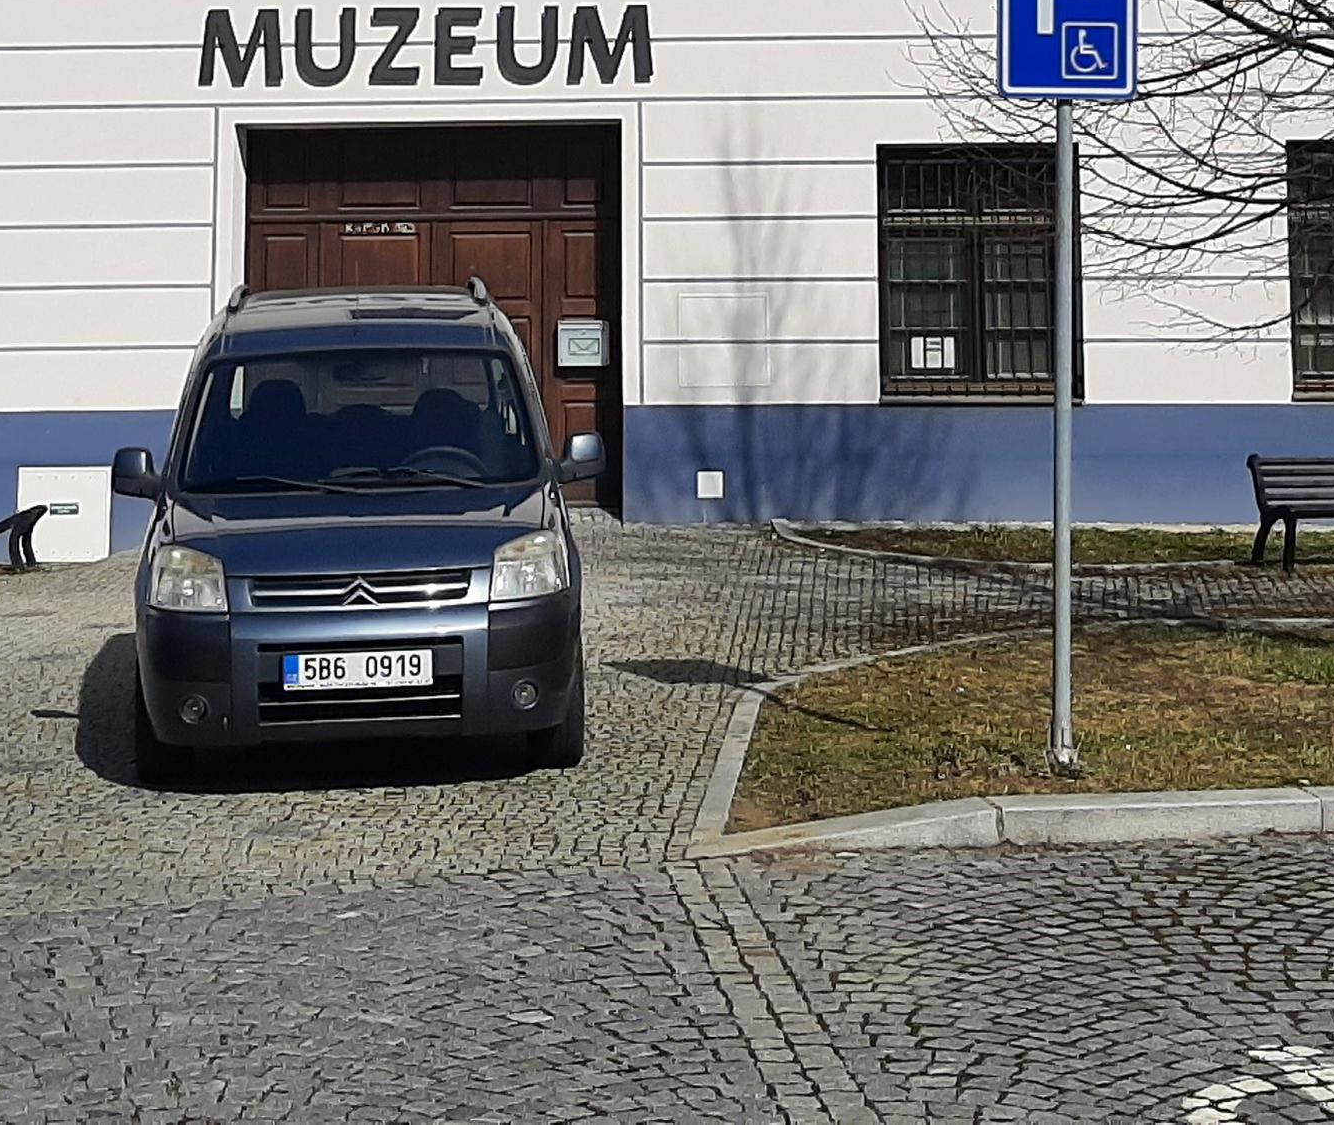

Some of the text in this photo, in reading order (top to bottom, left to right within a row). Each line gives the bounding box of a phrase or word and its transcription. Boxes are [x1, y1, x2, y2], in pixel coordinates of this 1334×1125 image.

[198, 5, 654, 88] MUZEUM
[304, 654, 421, 680] 5B6 0919
